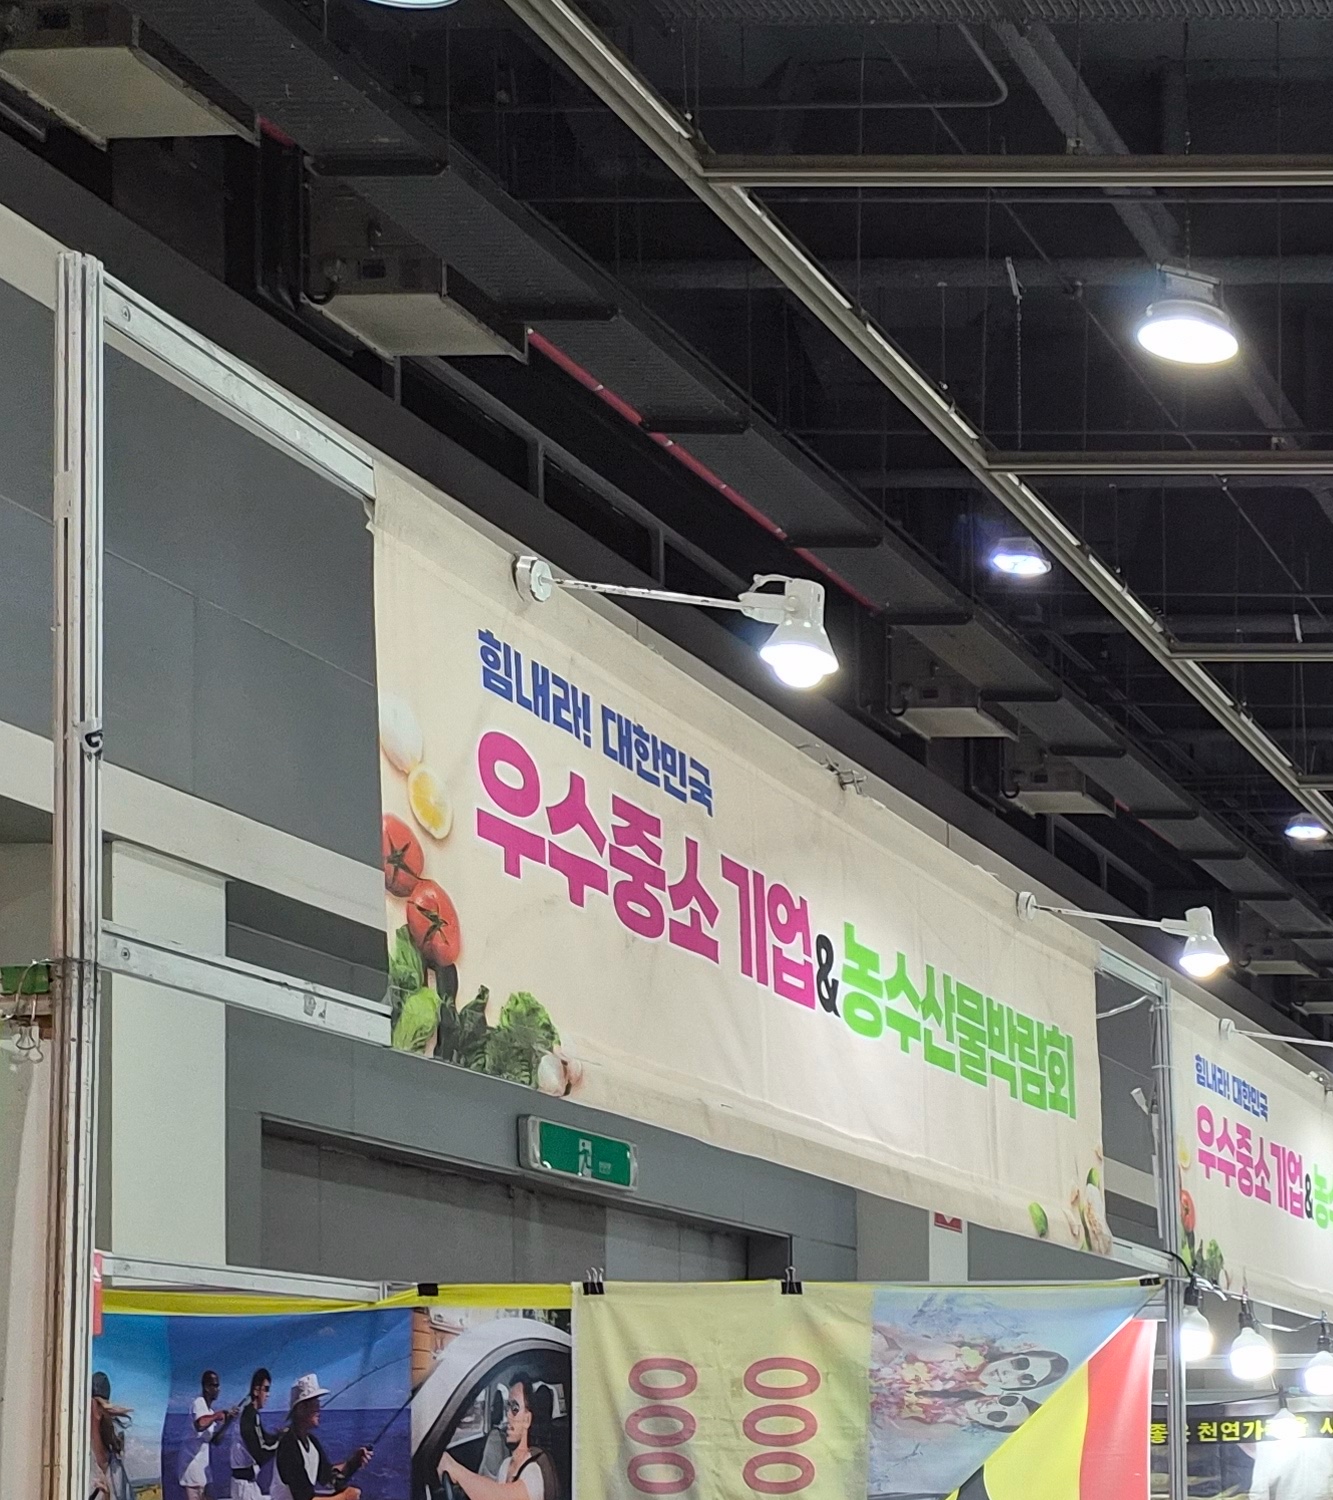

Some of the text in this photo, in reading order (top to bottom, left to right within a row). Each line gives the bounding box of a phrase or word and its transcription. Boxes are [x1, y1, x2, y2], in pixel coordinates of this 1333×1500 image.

[478, 628, 713, 818] 힘내라! 대한민국
[1195, 1054, 1268, 1122] 힘내라! 대한민국
